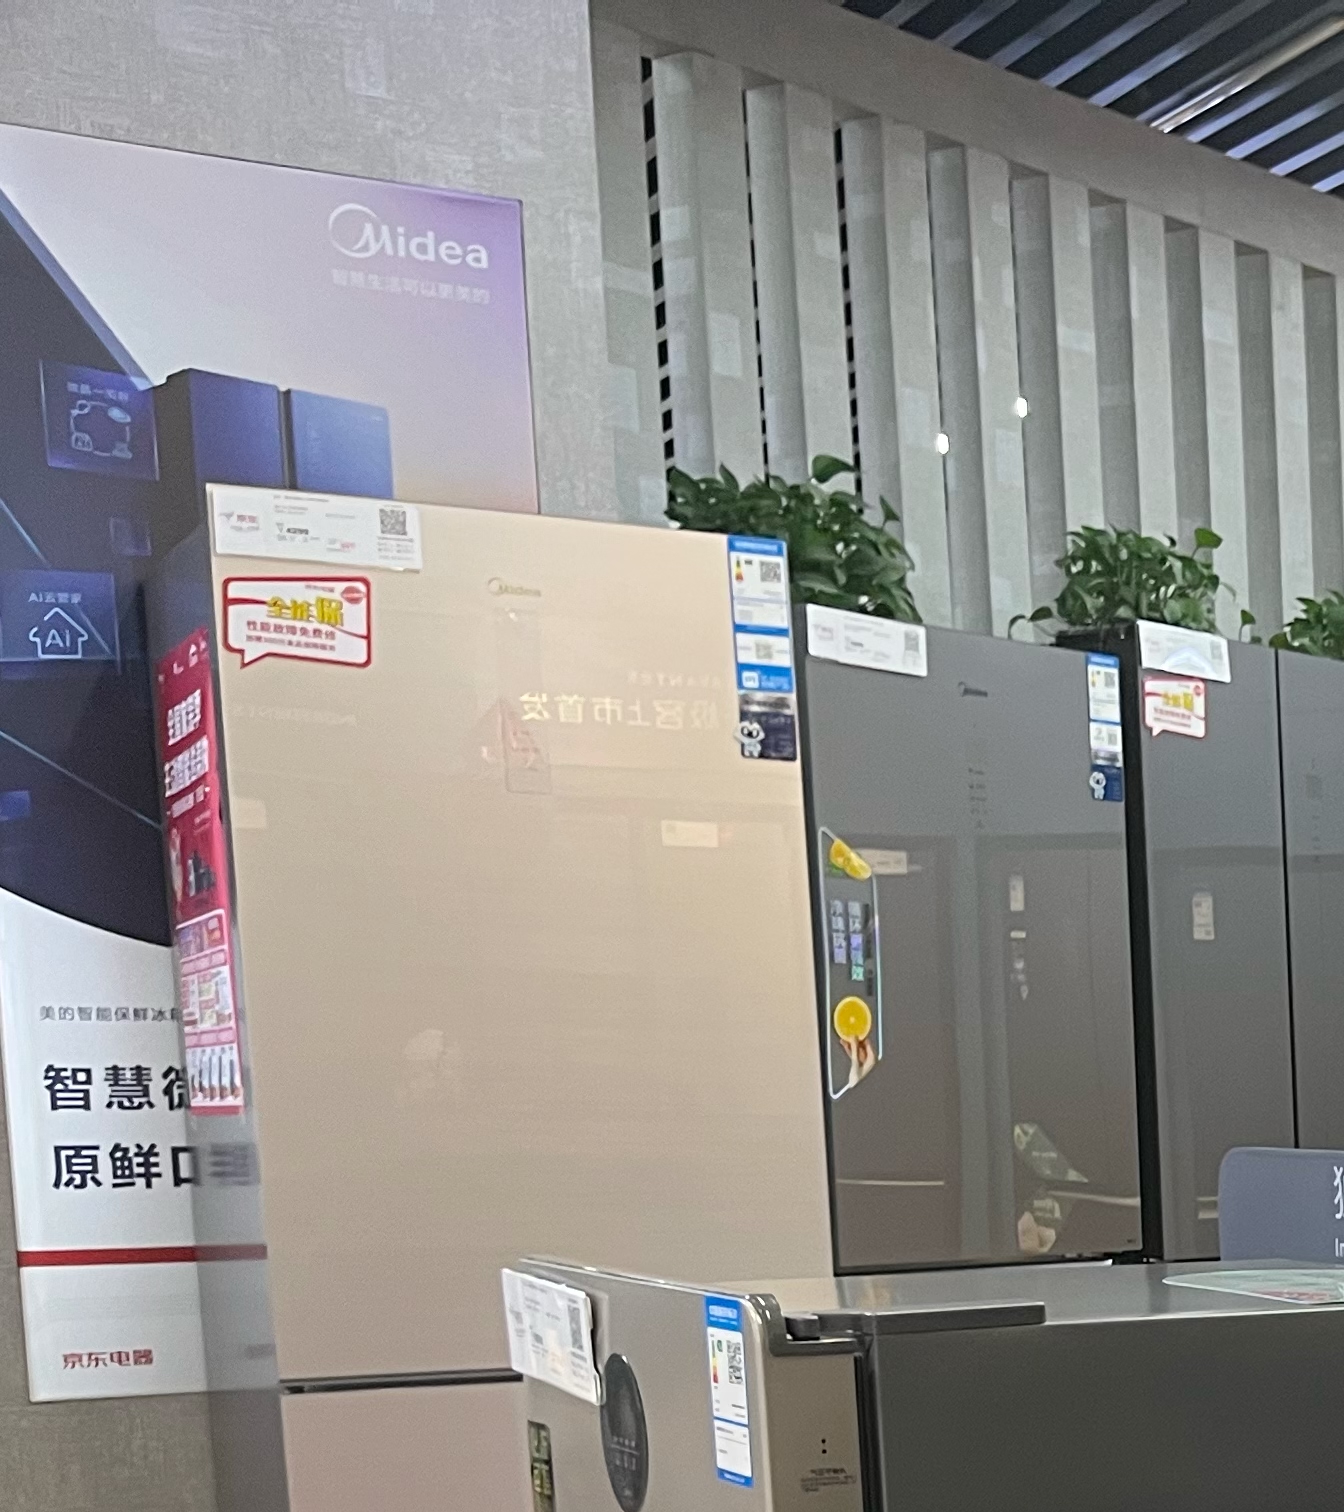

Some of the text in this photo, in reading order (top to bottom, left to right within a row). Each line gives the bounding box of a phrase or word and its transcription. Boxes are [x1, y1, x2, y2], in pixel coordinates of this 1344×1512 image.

[328, 202, 489, 269] Midea
[61, 1349, 154, 1370] 京东电器
